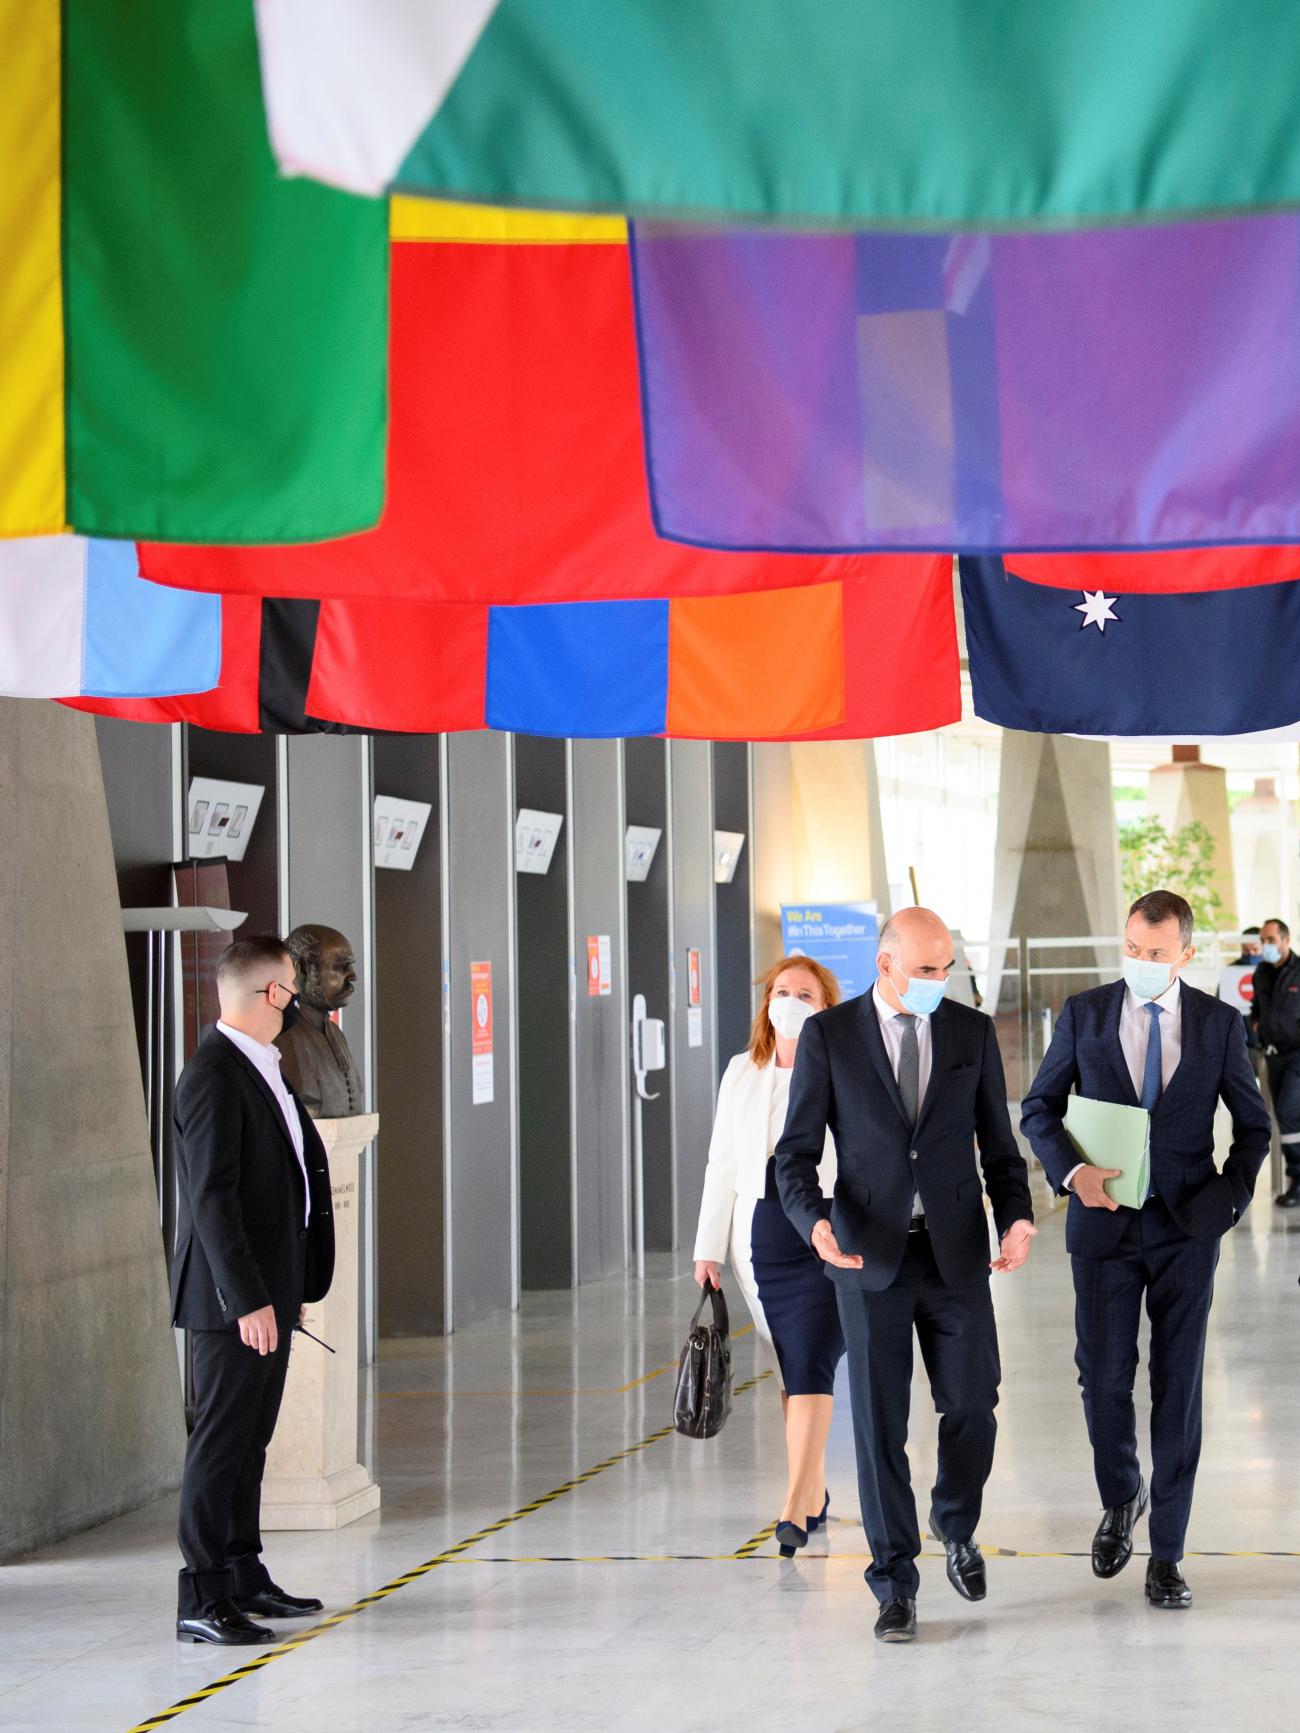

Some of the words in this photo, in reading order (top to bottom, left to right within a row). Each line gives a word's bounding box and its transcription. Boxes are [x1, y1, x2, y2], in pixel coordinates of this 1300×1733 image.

[787, 911, 802, 921] We
[805, 911, 822, 921] Are
[788, 924, 865, 937] #InThisTogether
